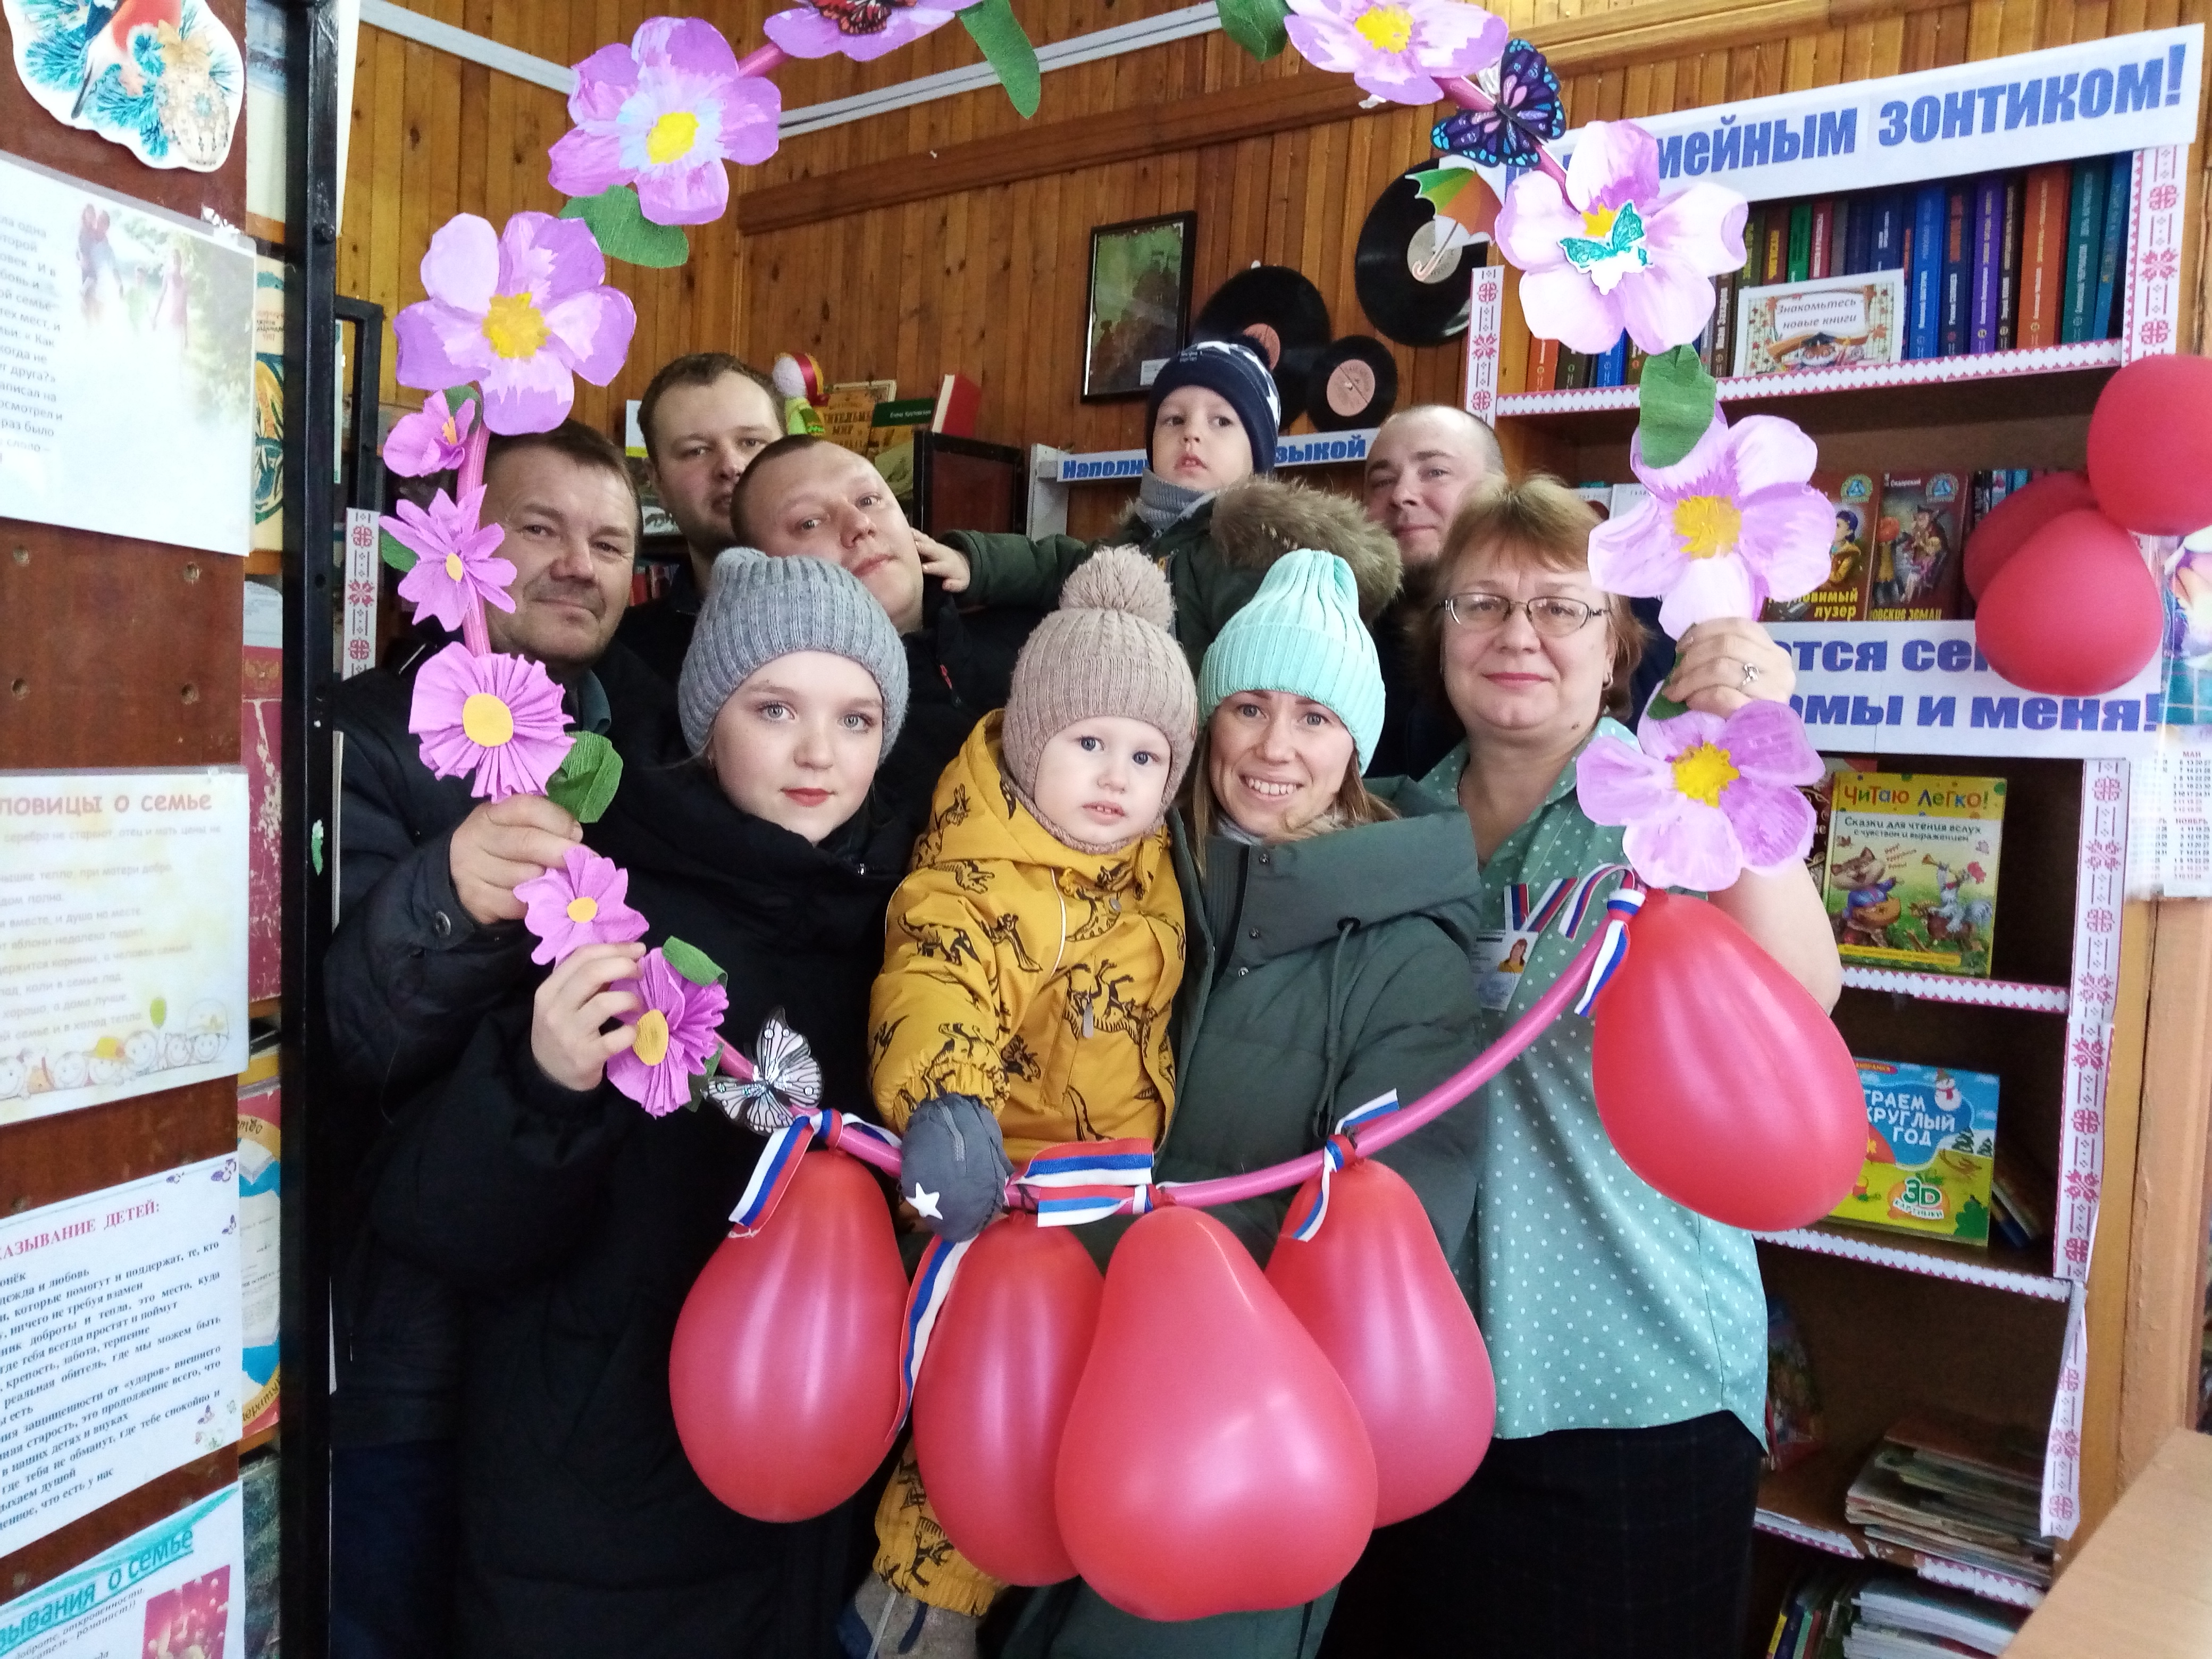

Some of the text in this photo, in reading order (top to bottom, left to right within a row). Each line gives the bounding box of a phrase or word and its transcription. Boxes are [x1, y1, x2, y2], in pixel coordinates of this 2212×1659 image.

[1878, 43, 2187, 147] зонтиком!
[1777, 298, 1856, 315] Знакомьтесь
[1782, 314, 1858, 330] новые книги
[44, 392, 56, 404] на
[56, 413, 63, 422] и
[24, 421, 54, 438] было
[1814, 605, 1857, 622] лузер
[1917, 695, 1957, 727] и
[1970, 693, 2162, 733] меня!
[1892, 1126, 1932, 1147] ГОД
[1902, 1177, 1942, 1207] 3D
[104, 1199, 160, 1230] ДЕТЕЙ:
[15, 1294, 62, 1317] которые
[66, 1277, 111, 1299] помогут
[115, 1273, 122, 1282] и
[203, 1241, 219, 1253] кто
[39, 1283, 45, 1292] и
[49, 1269, 89, 1288] любовь
[11, 1283, 143, 1336] ничего не требуя взамен
[30, 1321, 77, 1346] доброты
[85, 1316, 91, 1325] и
[138, 1294, 155, 1305] это
[198, 1271, 220, 1286] куда
[22, 1349, 45, 1365] тебя
[48, 1335, 83, 1355] всегда
[86, 1318, 128, 1340] простят
[141, 1302, 178, 1320] поймут
[5, 1379, 55, 1409] реальная
[112, 1349, 129, 1362] где
[135, 1341, 152, 1353] мы
[157, 1327, 191, 1345] можем
[196, 1316, 221, 1331] быть
[6, 1363, 59, 1389] крепость,
[103, 1327, 150, 1348] терпение
[23, 1392, 103, 1434] защищенности
[107, 1386, 119, 1396] от
[124, 1367, 170, 1390] «ударов»
[174, 1346, 221, 1370] внешнего
[27, 1422, 78, 1448] старость,
[81, 1410, 98, 1423] это
[102, 1381, 169, 1415] продолжение
[204, 1360, 221, 1371] что
[10, 1406, 33, 1422] есть
[2, 1479, 20, 1495] где
[26, 1465, 49, 1484] тебя
[54, 1458, 65, 1471] не
[120, 1425, 136, 1439] где
[140, 1412, 161, 1429] тебе
[165, 1393, 210, 1419] спокойно
[214, 1389, 220, 1398] и
[2, 1412, 128, 1478] в наших детях и внуках
[41, 1467, 76, 1494] душой
[41, 1494, 60, 1509] что
[63, 1482, 85, 1499] есть
[88, 1477, 94, 1489] у
[97, 1467, 114, 1482] нас
[107, 1568, 123, 1591] о
[128, 1529, 194, 1579] семье
